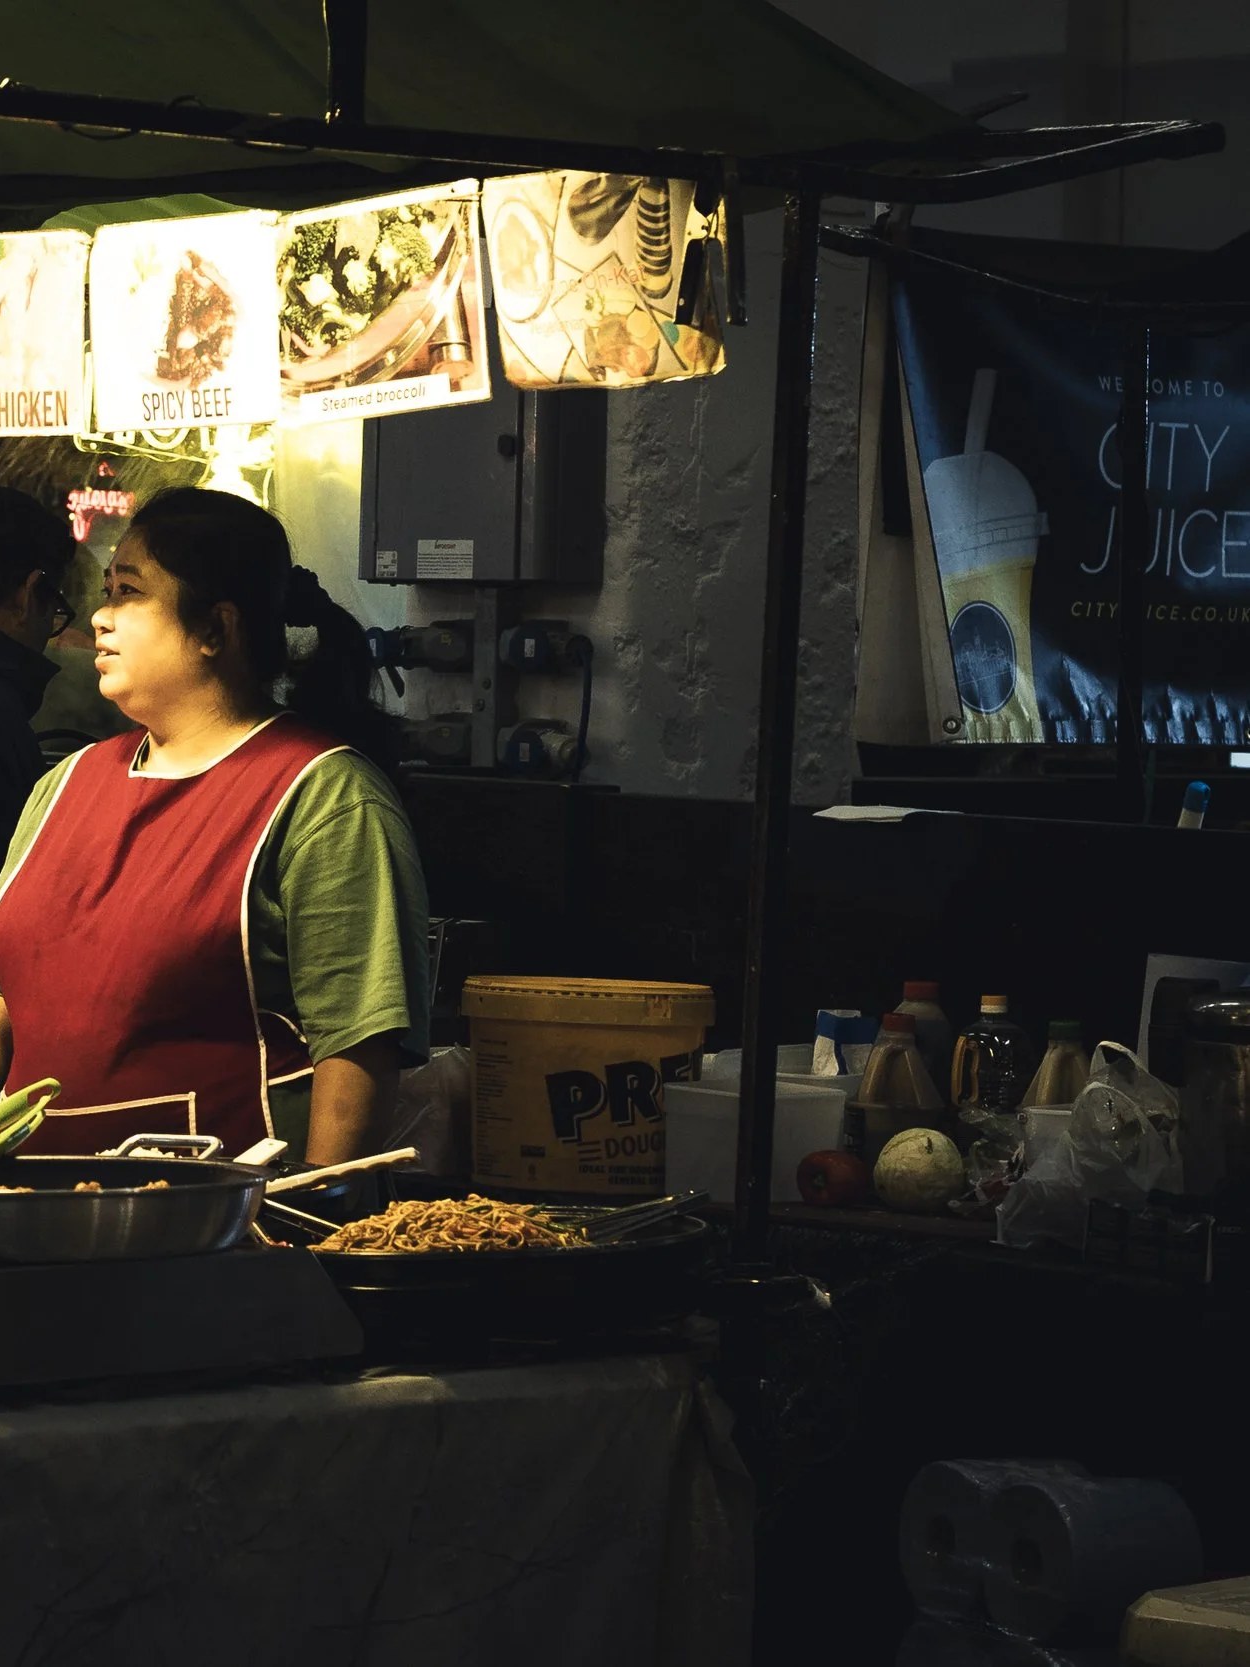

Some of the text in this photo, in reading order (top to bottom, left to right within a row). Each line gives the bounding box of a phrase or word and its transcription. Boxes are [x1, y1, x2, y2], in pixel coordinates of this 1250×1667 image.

[321, 385, 426, 412] Steamed broccoli
[1098, 375, 1225, 398] WEOME TO
[141, 387, 233, 422] SPICY BEEF
[1098, 421, 1231, 493] CITY
[1071, 601, 1250, 625] CITYICE.CO.UK
[605, 1130, 666, 1160] DOUG
